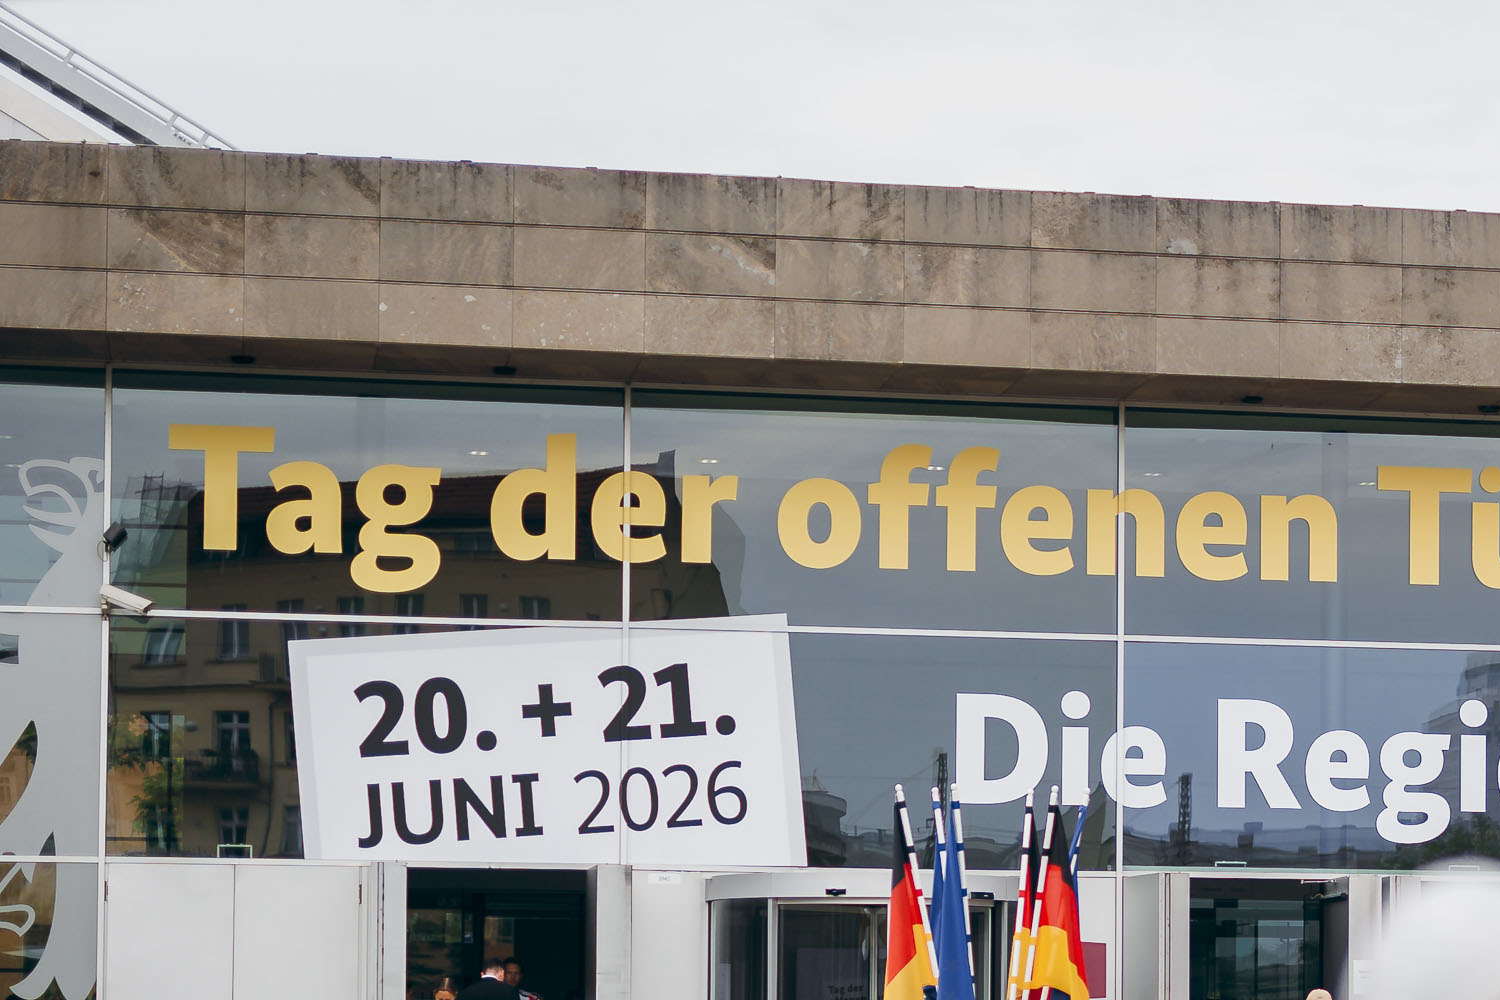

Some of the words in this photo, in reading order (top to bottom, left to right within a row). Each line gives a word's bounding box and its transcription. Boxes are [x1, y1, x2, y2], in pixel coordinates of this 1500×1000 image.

[168, 424, 442, 593] Tag
[490, 433, 739, 564] der
[777, 443, 1338, 582] offenen
[353, 676, 498, 758] 20.
[521, 683, 572, 738] +
[597, 662, 738, 743] 21.
[954, 690, 1168, 808] Die
[358, 772, 544, 850] JUNI
[573, 760, 748, 836] 2026
